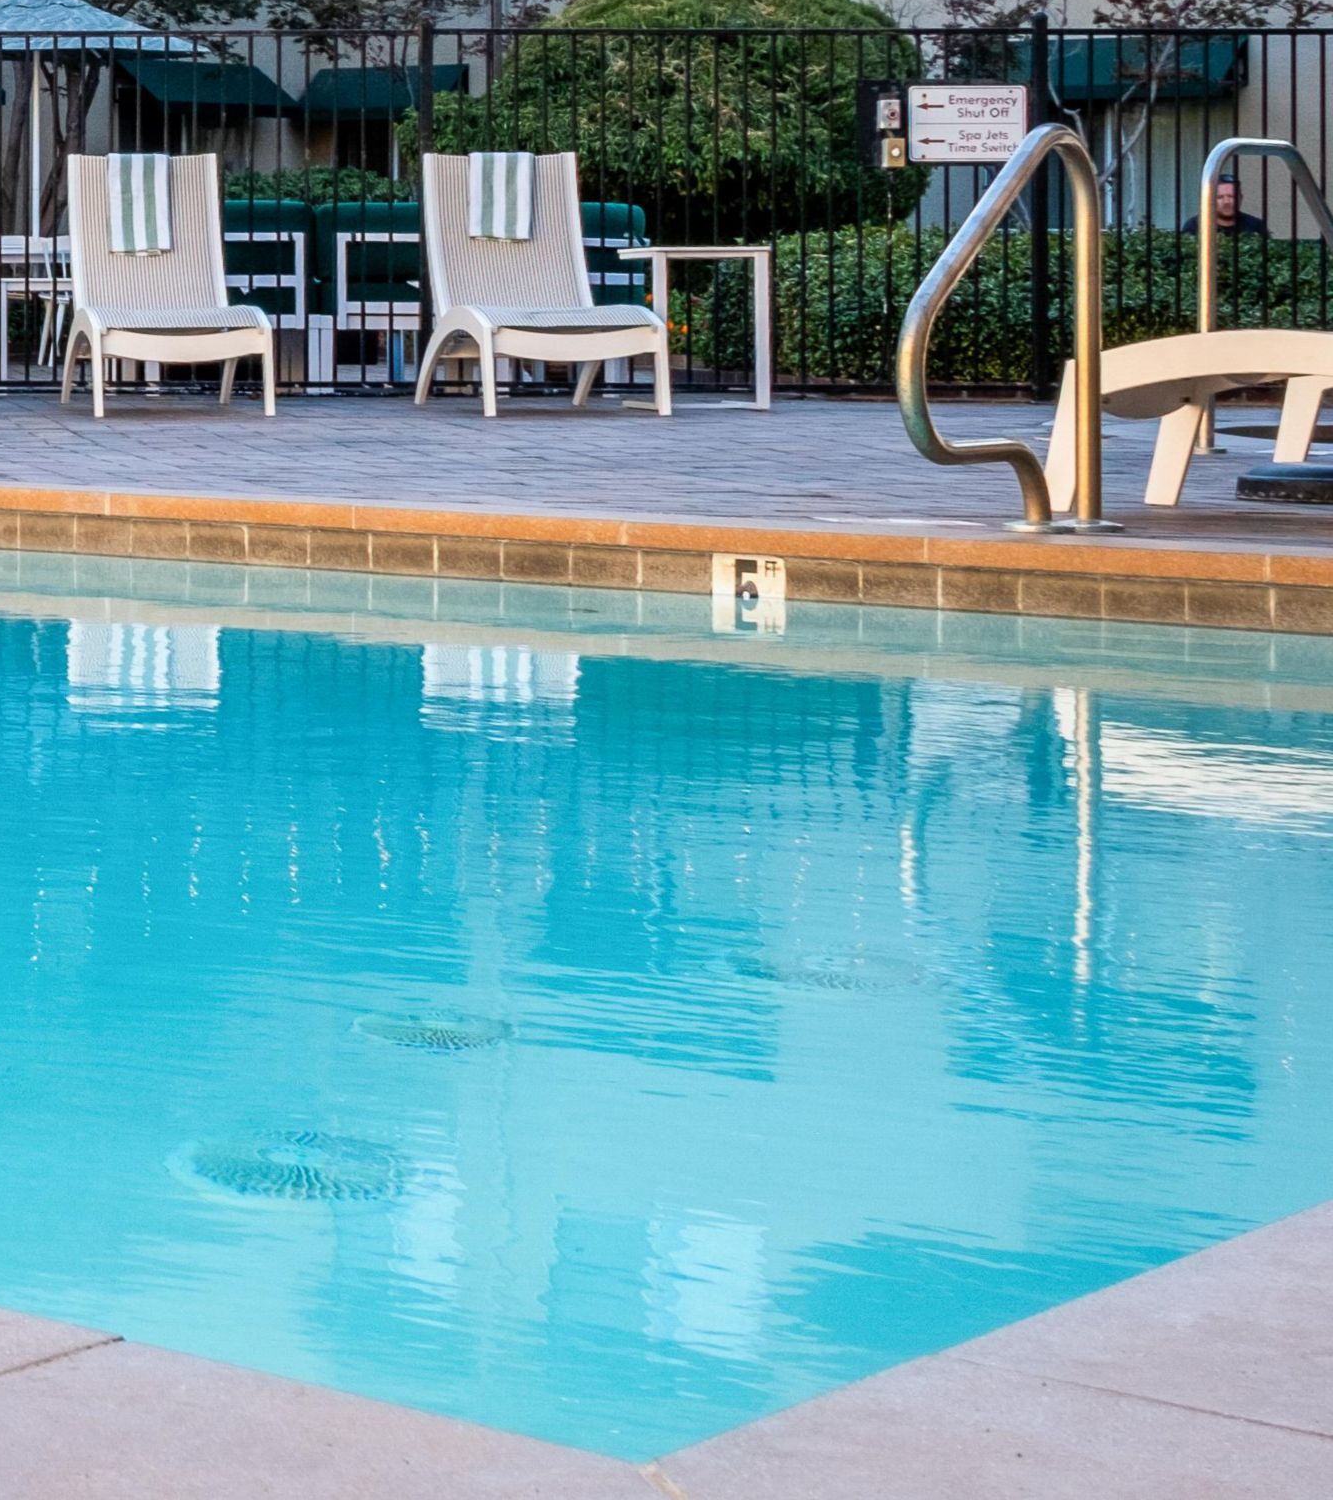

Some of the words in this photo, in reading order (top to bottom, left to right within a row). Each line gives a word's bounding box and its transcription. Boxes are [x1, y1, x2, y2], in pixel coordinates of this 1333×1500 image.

[948, 94, 1018, 107] Emergency
[957, 107, 985, 118] Shut
[989, 107, 1010, 118] Off
[958, 130, 982, 141] Spa
[985, 130, 1009, 140] Jets
[948, 142, 977, 153] Time
[765, 560, 778, 577] FT
